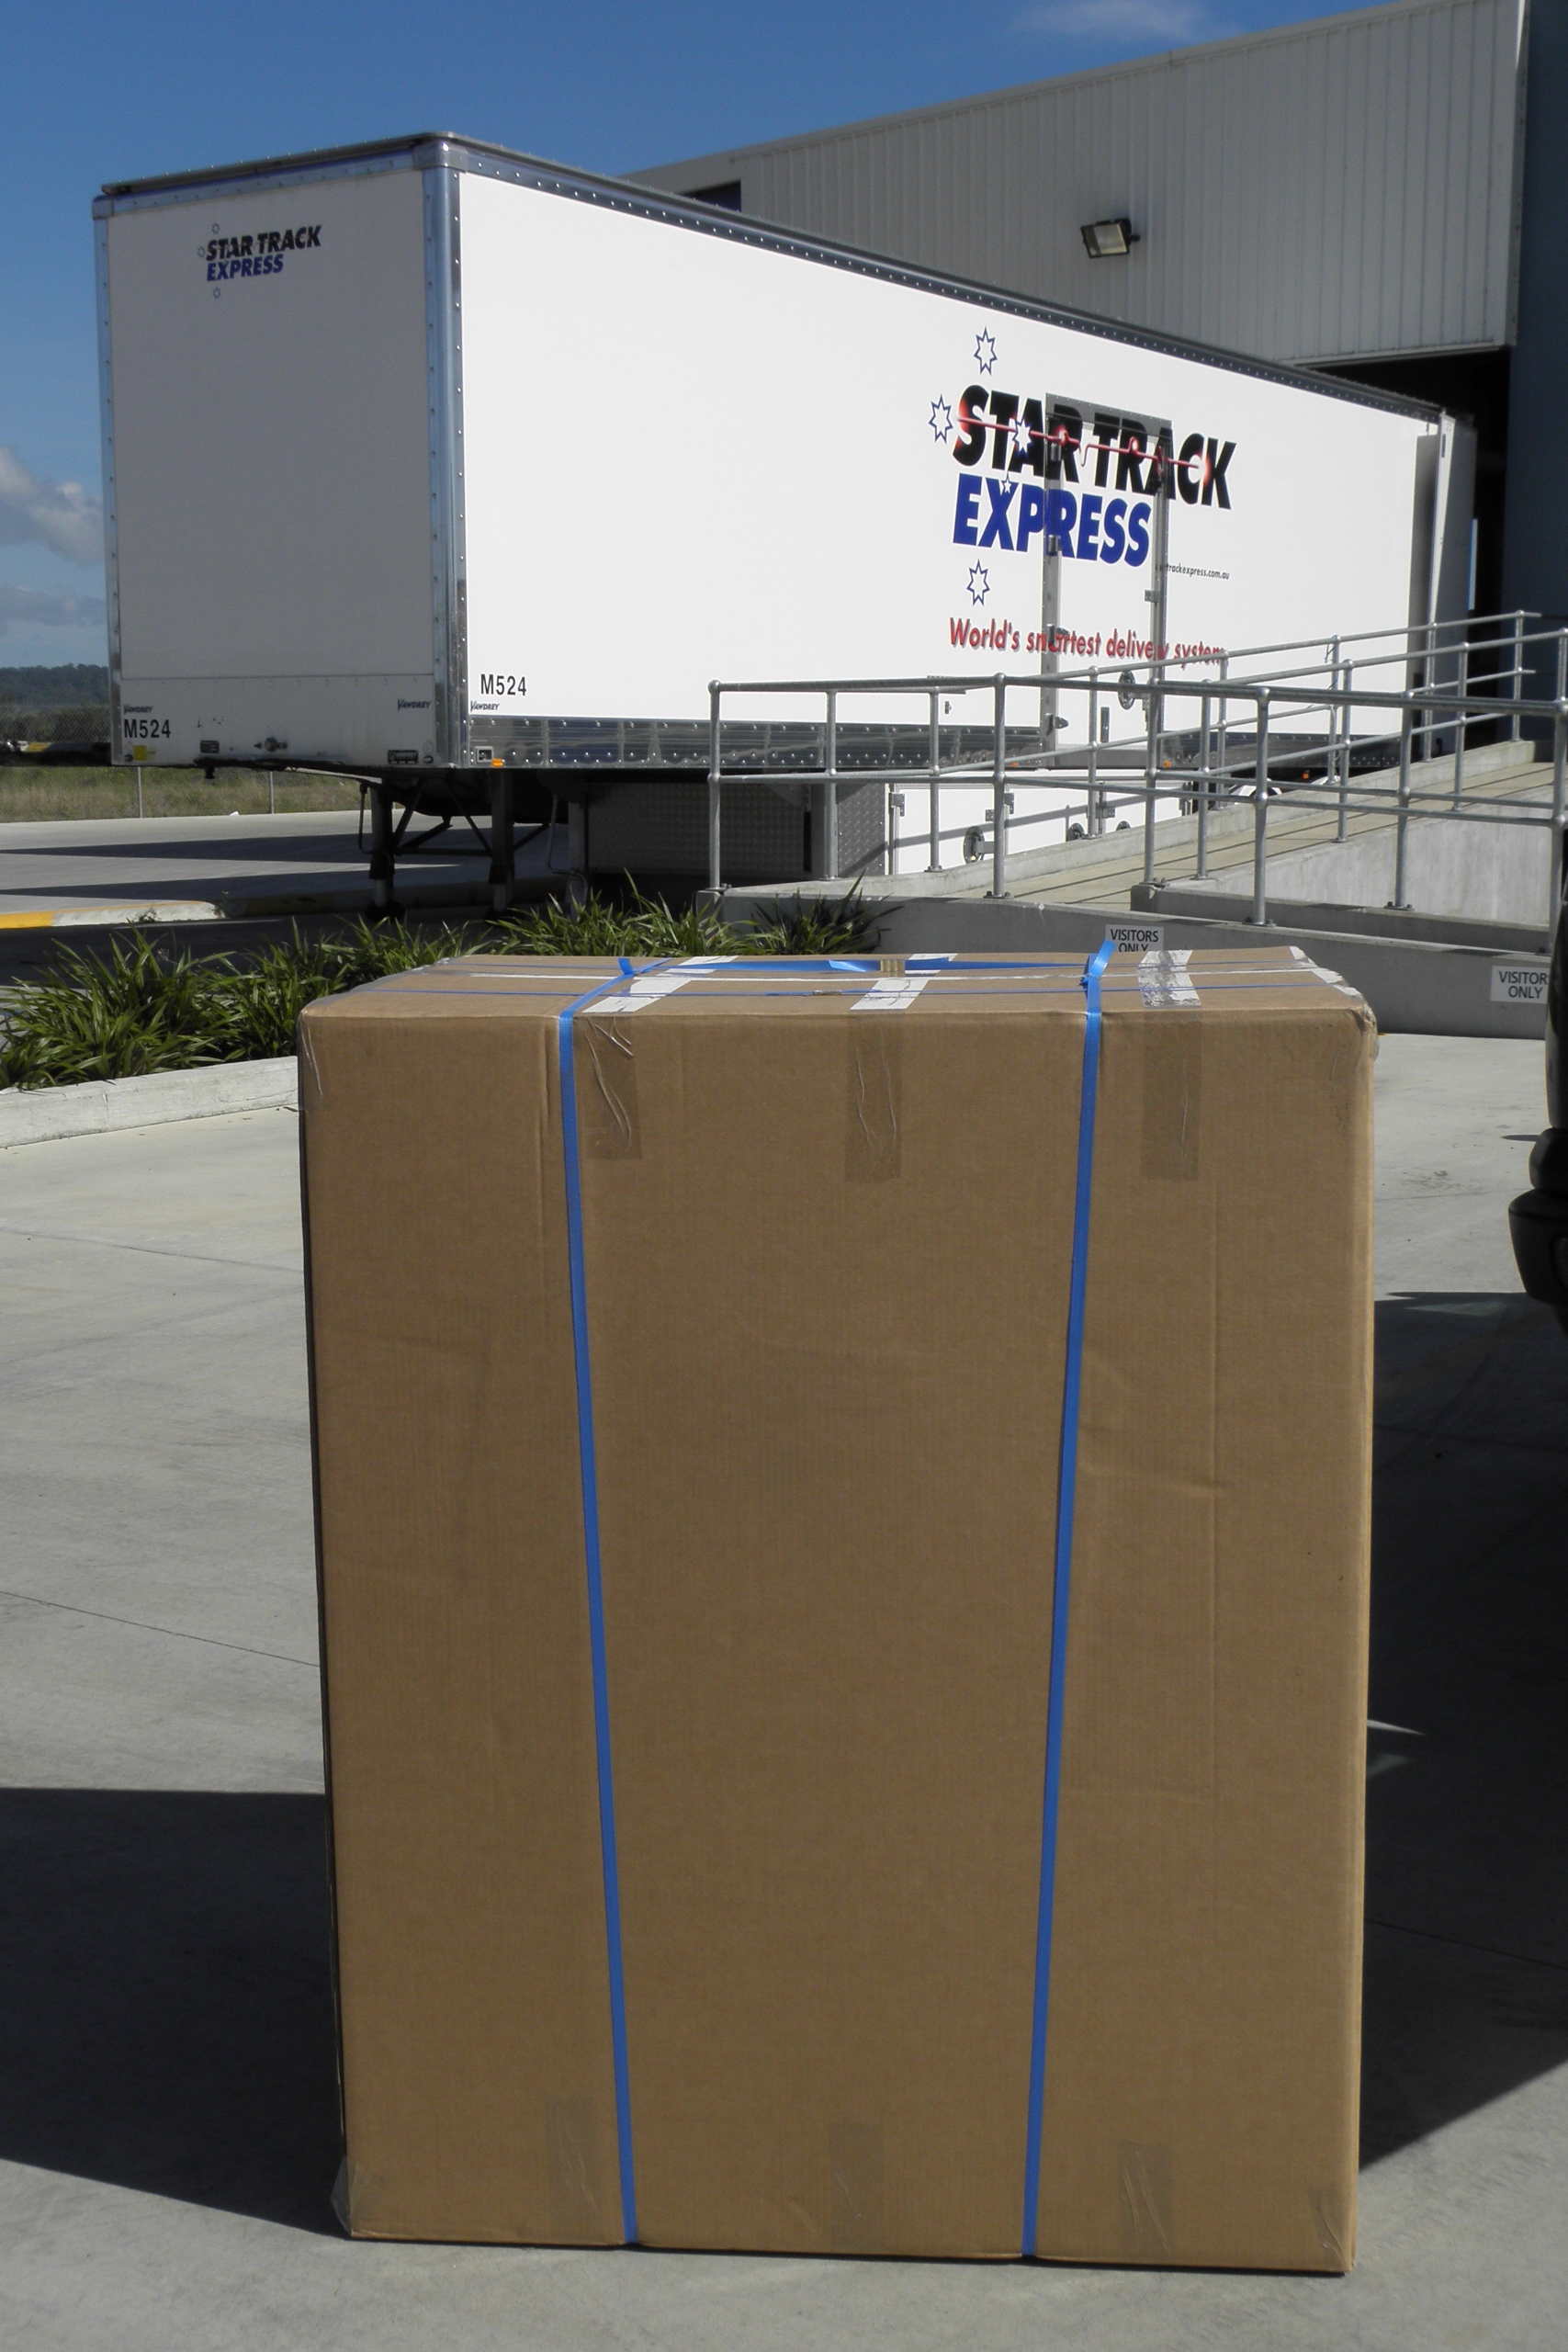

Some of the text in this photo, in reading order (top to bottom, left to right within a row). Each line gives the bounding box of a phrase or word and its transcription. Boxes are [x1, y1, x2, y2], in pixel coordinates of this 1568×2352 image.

[206, 225, 321, 261] STAR TRACK
[207, 254, 284, 281] EXPRESS
[953, 384, 1237, 510] STAR TRACK
[953, 473, 1152, 567] EXPRESS
[1156, 562, 1230, 580] trackexpress.com.au
[950, 617, 1021, 650] World's
[480, 673, 527, 696] M524
[124, 718, 172, 739] M524
[1111, 928, 1159, 943] VISITORS
[1499, 970, 1548, 985] VISITOR
[1508, 985, 1543, 1000] ONLY
